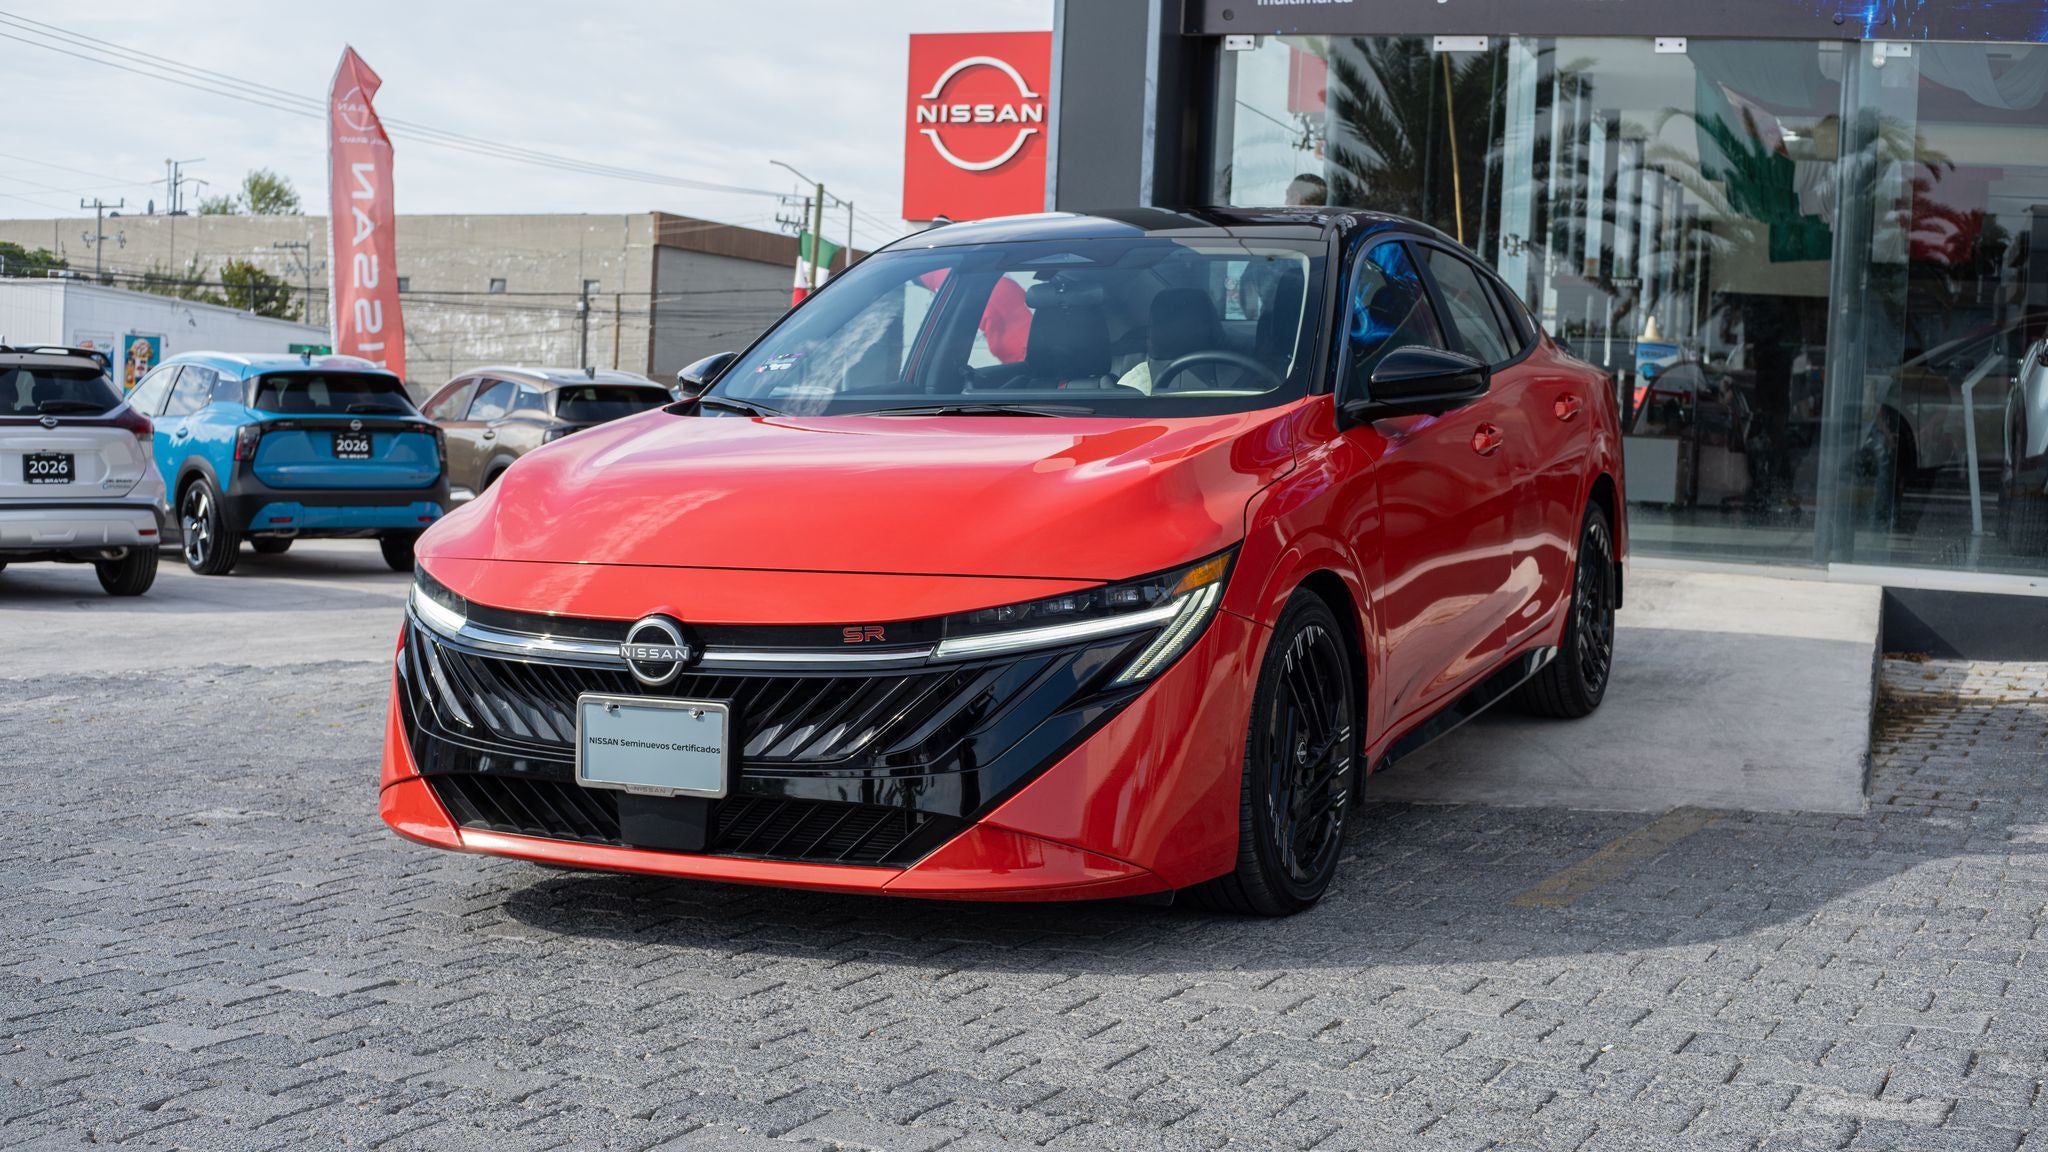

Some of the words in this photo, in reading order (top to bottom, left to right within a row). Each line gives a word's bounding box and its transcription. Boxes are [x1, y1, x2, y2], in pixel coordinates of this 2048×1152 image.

[916, 103, 1043, 123] NISSAN
[336, 439, 369, 452] 2026
[29, 460, 68, 474] 2026
[842, 625, 886, 644] SR
[621, 646, 688, 659] NISSAN
[589, 736, 619, 746] NISSAN
[620, 739, 670, 751] Seminuevos
[671, 742, 721, 754] Certificados
